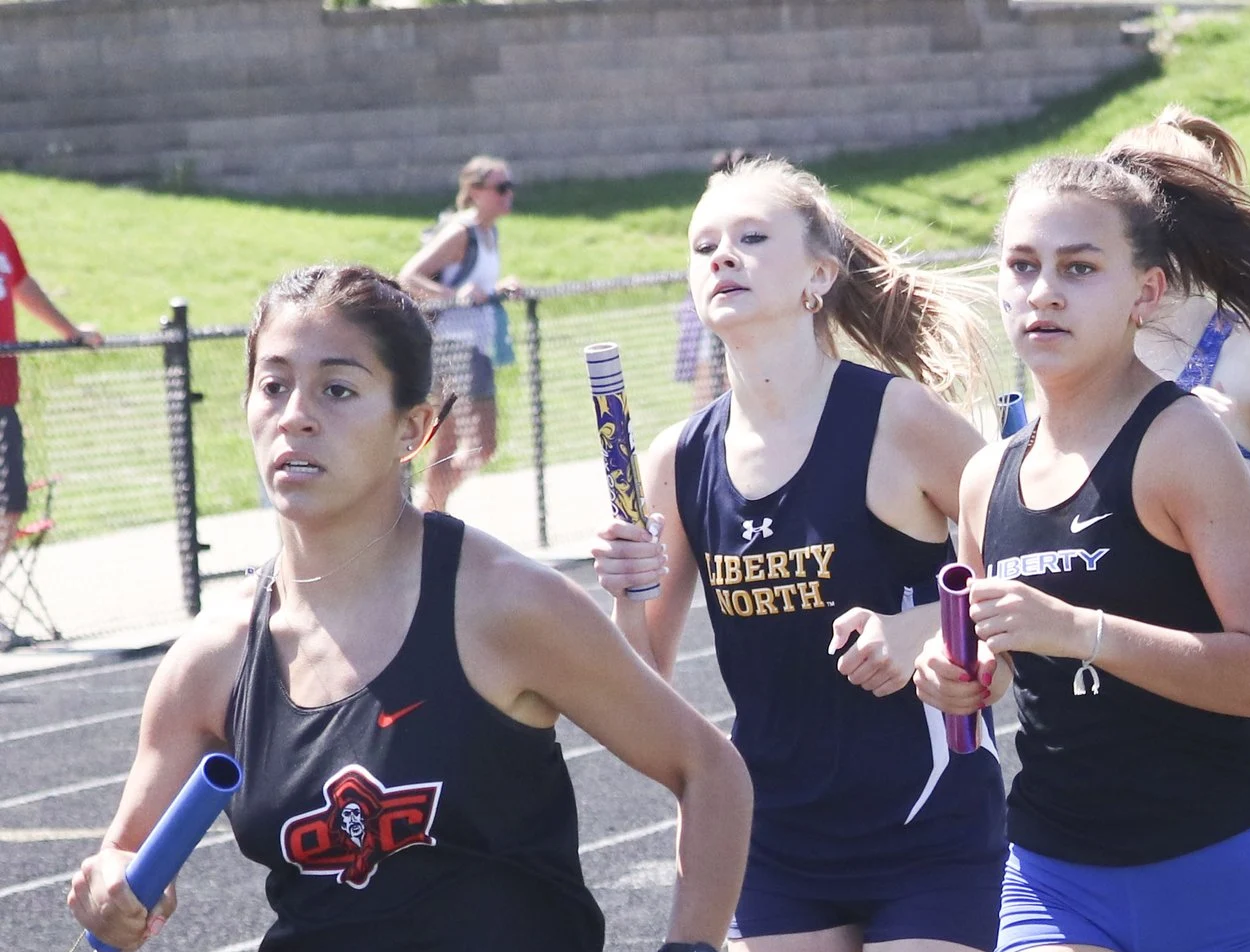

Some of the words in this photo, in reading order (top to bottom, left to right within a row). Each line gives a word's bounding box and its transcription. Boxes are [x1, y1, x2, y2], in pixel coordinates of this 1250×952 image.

[704, 543, 835, 586] LIBERTY
[986, 548, 1111, 581] LIBERTY
[715, 580, 825, 617] NORTH
